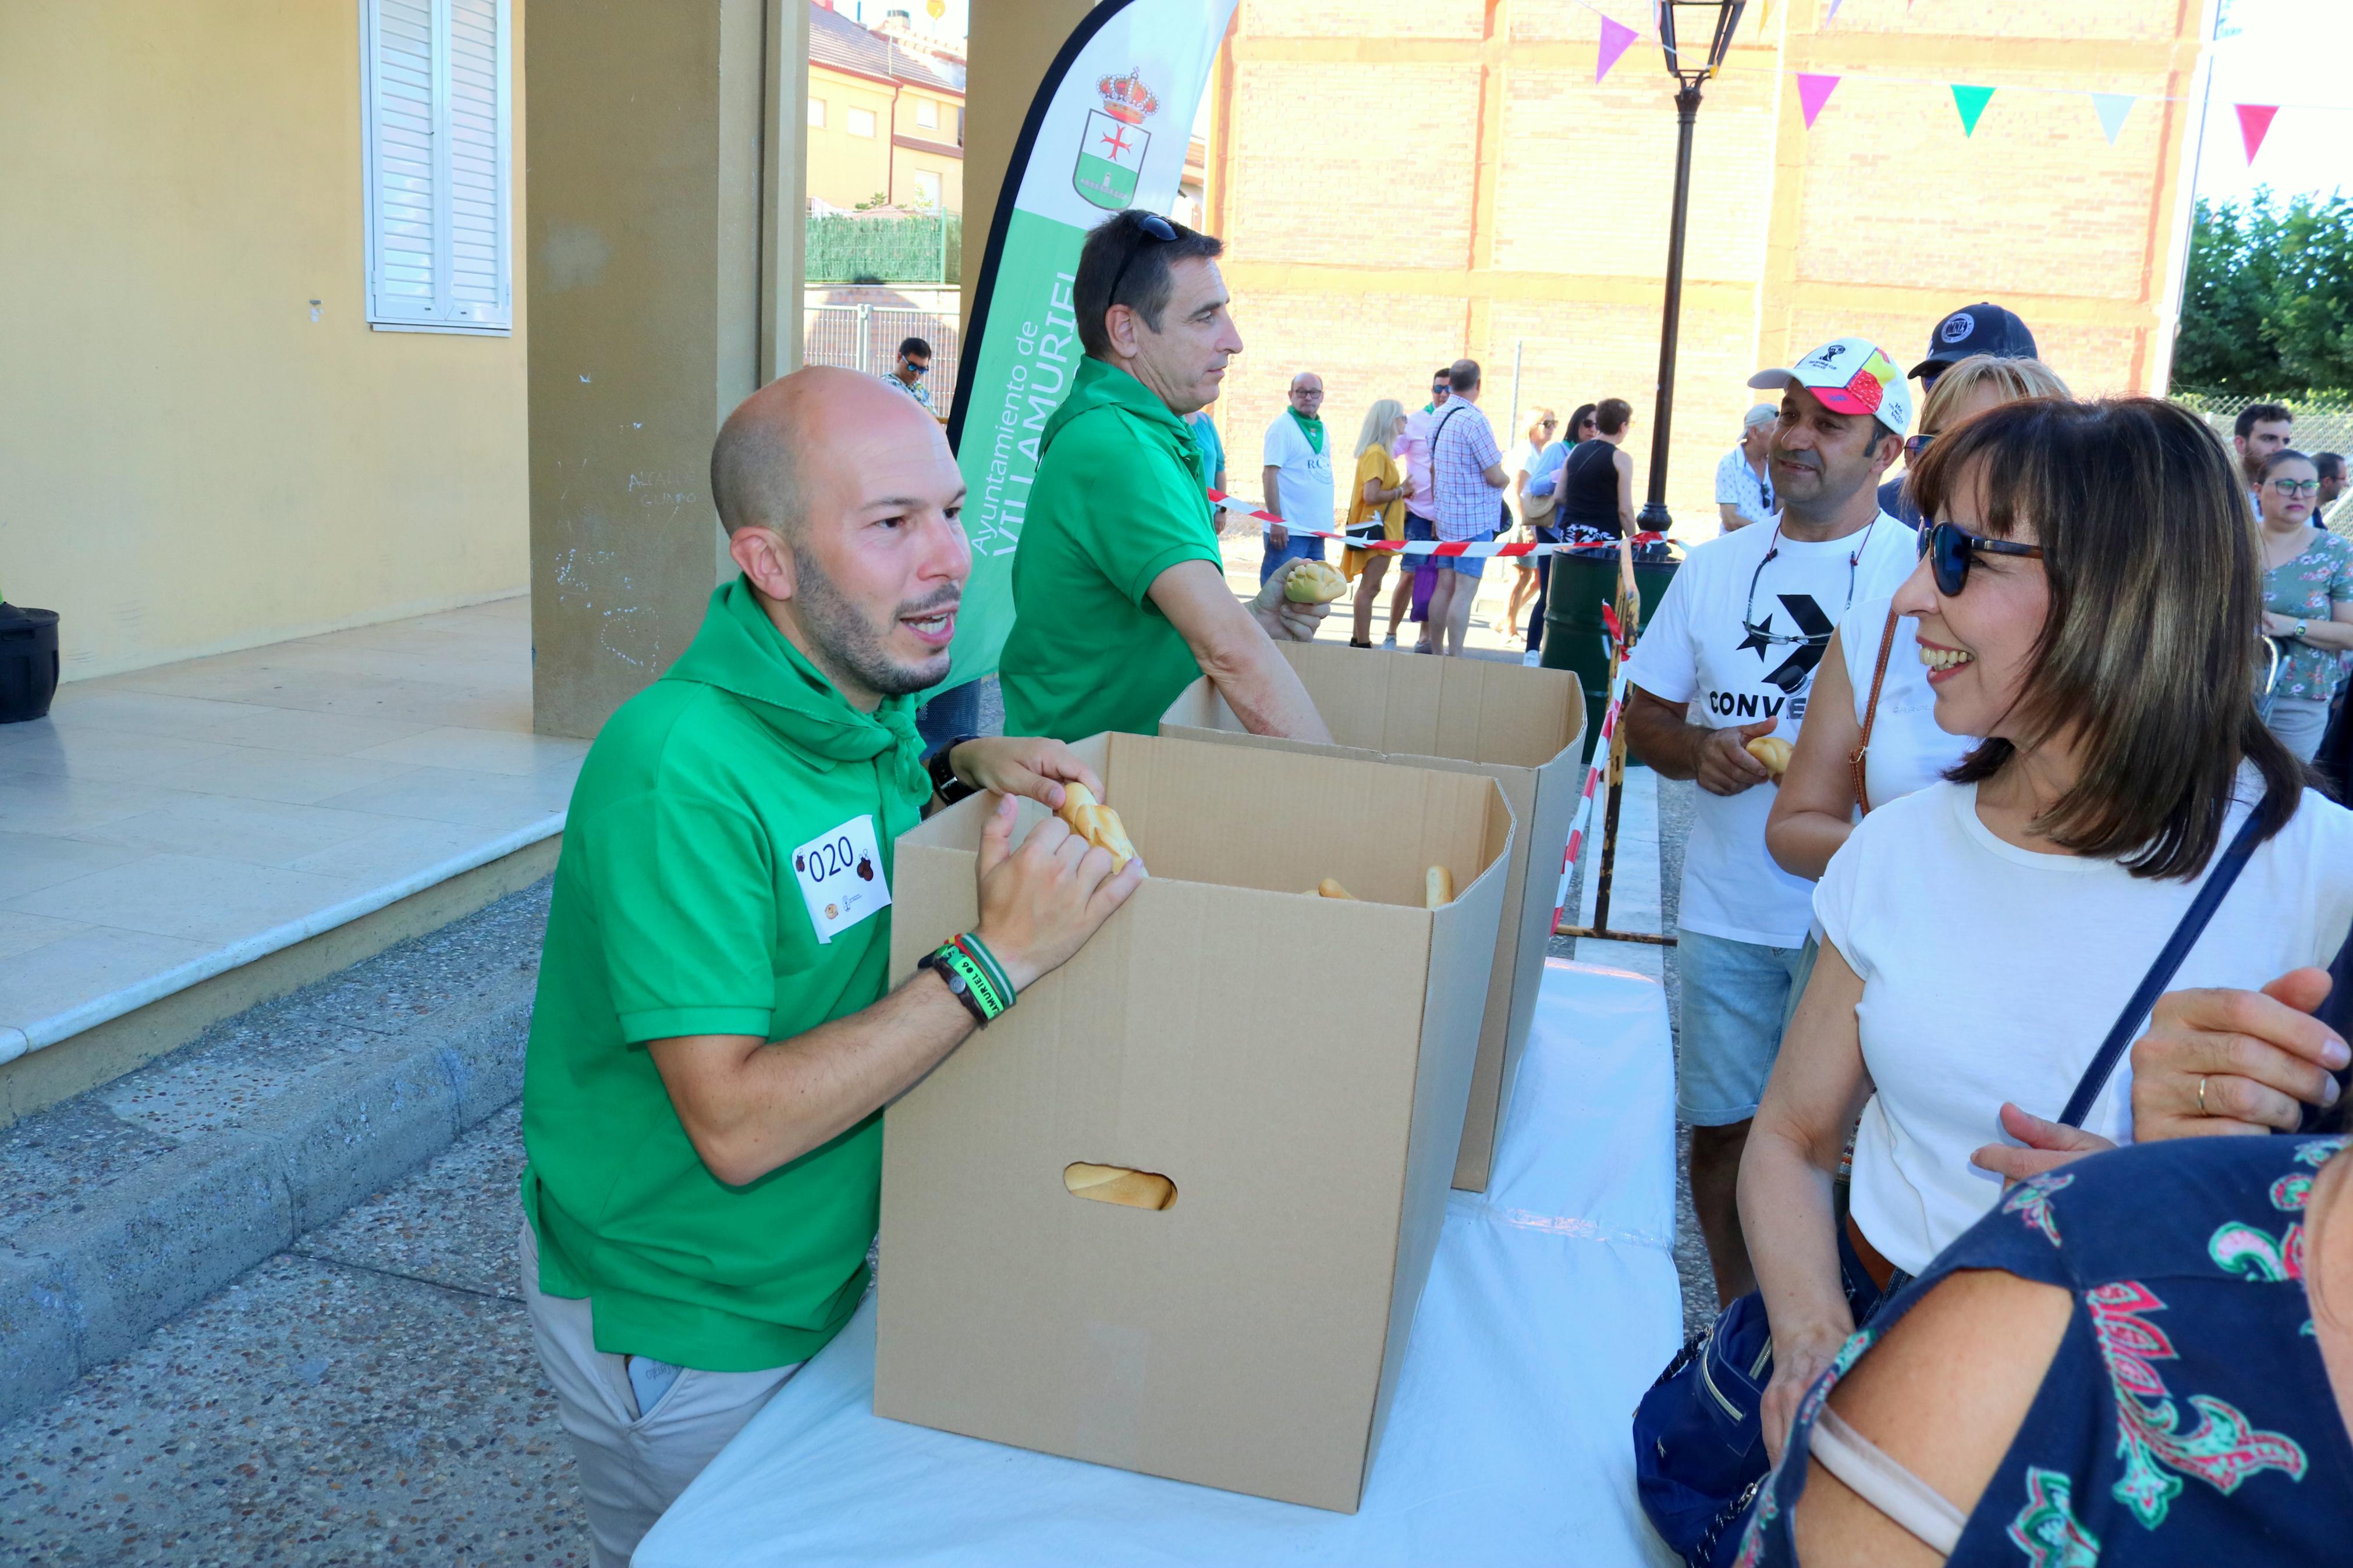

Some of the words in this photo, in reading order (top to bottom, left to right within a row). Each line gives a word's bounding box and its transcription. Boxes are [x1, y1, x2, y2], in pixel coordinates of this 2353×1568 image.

[971, 364, 1027, 557] Ayuntamiento
[1015, 321, 1038, 355] de
[809, 836, 853, 883] 020
